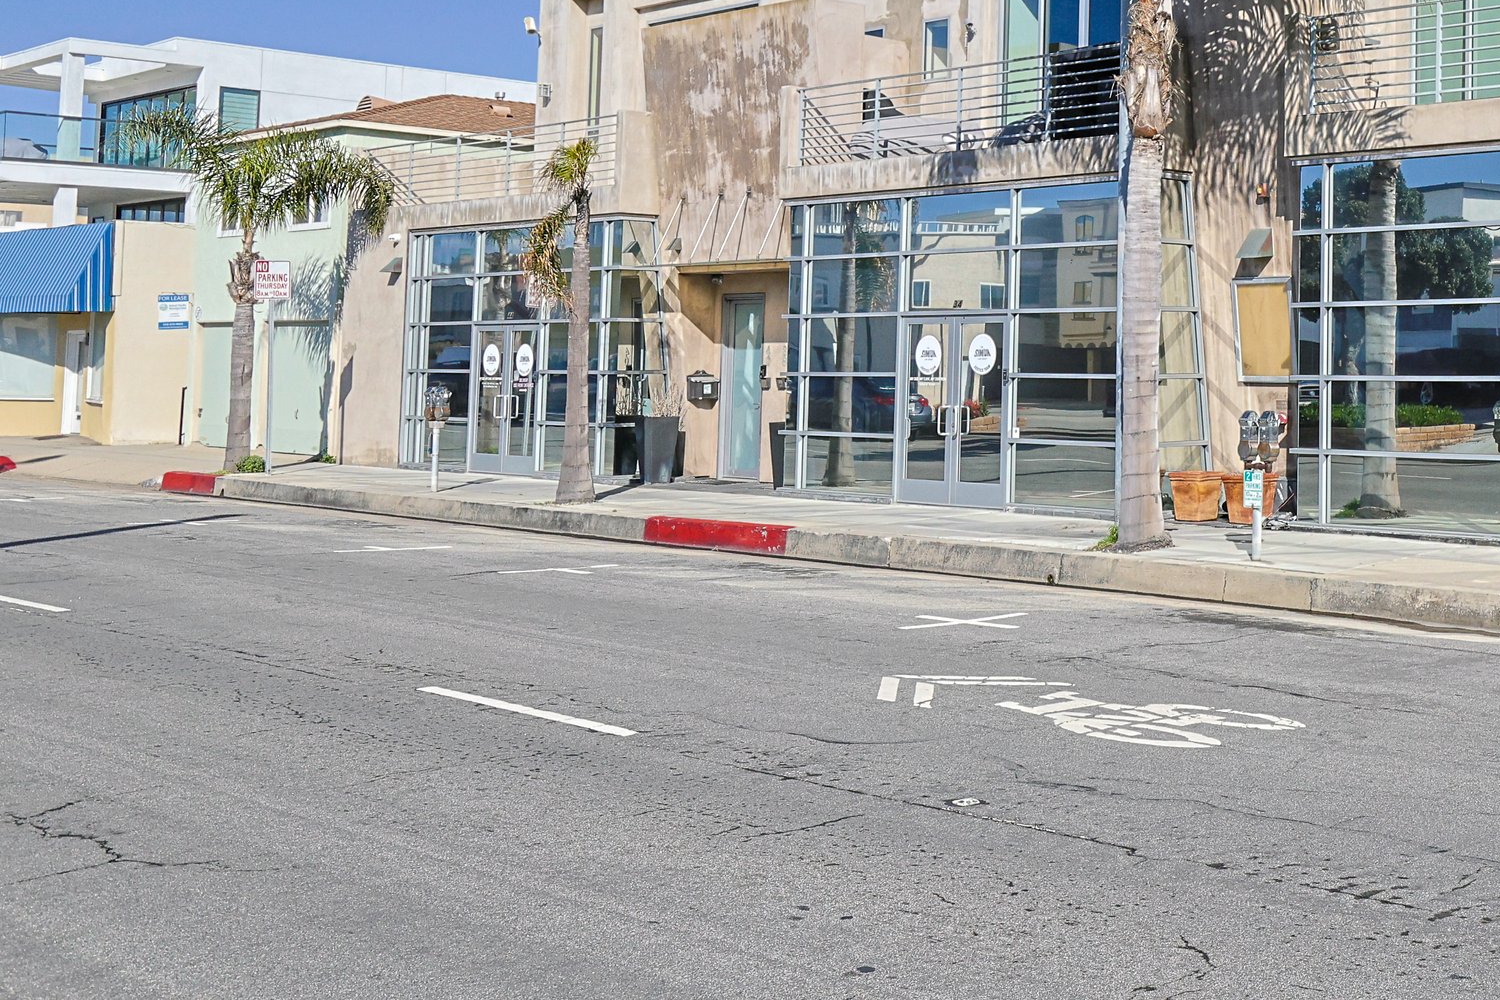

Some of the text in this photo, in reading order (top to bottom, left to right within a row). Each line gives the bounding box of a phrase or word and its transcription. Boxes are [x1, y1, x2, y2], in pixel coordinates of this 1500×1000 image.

[257, 262, 268, 271] NO
[258, 273, 288, 282] PARKING
[257, 282, 288, 290] THURSDAY
